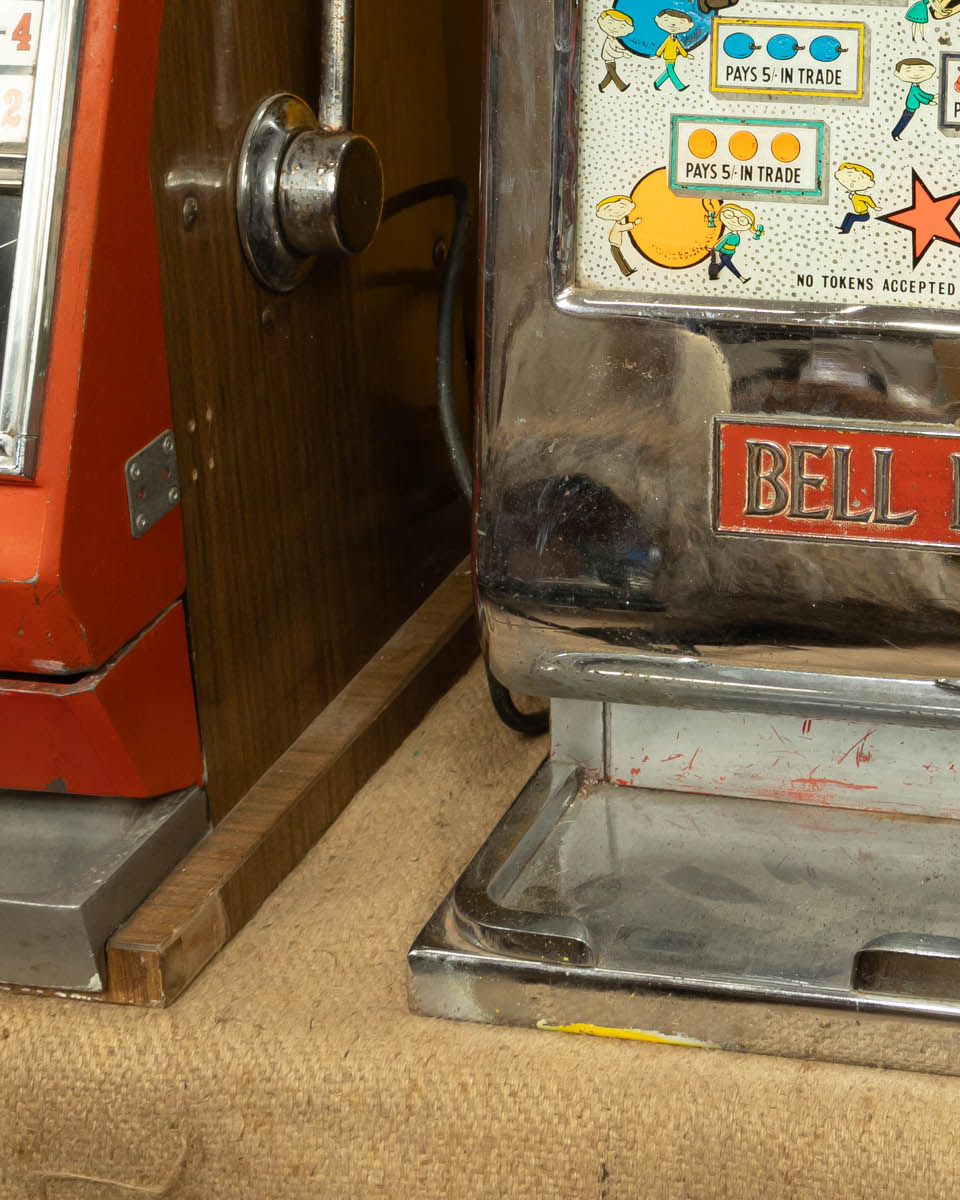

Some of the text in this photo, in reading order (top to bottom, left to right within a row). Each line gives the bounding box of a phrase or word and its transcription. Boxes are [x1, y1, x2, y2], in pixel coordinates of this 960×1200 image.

[726, 65, 758, 82] PAYS
[781, 67, 794, 84] IN
[798, 68, 842, 85] TRADE
[686, 162, 718, 180] PAYS
[740, 165, 753, 182] IN
[757, 166, 801, 183] TRADE
[796, 274, 814, 288] NO
[822, 275, 875, 291] TOKENS
[882, 279, 956, 297] ACCEPTED
[742, 437, 918, 528] BELL
